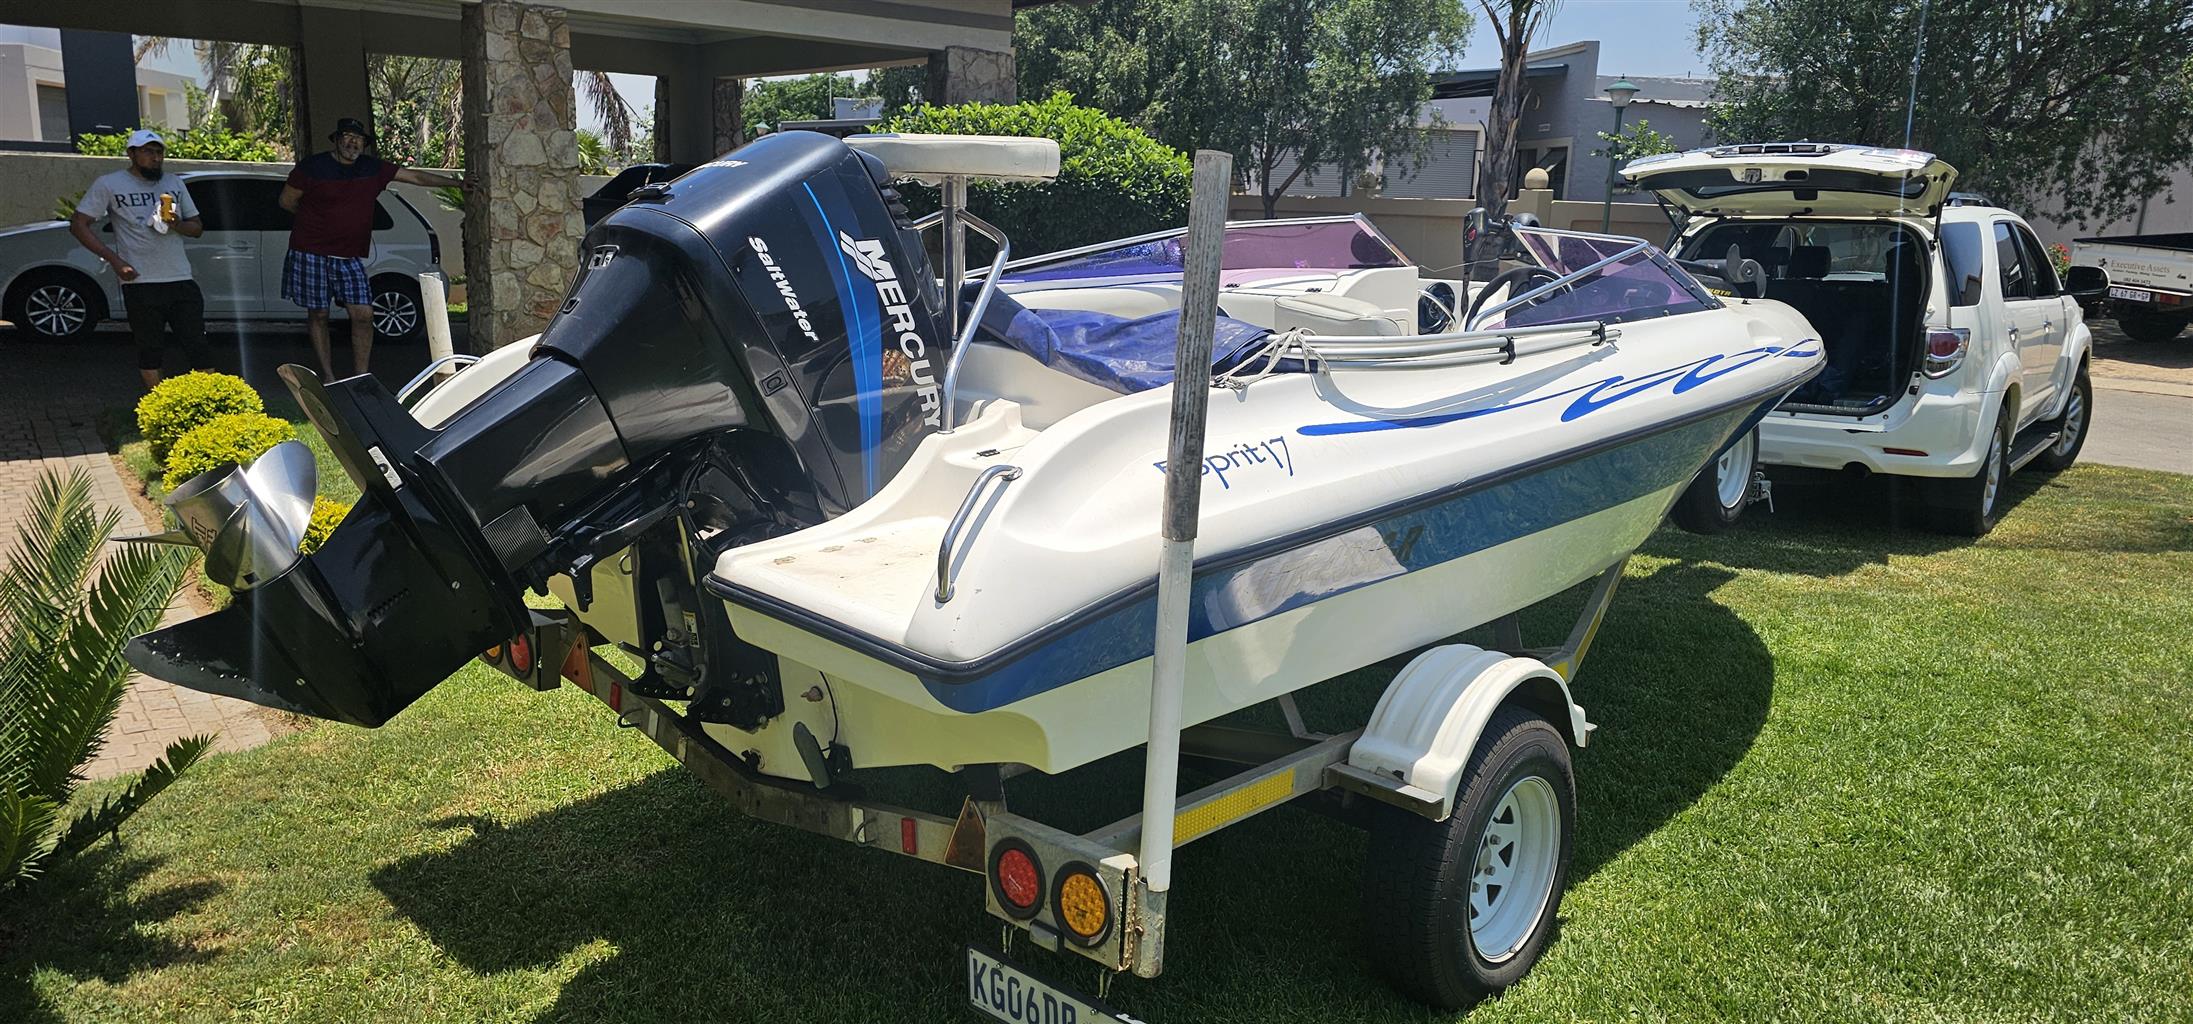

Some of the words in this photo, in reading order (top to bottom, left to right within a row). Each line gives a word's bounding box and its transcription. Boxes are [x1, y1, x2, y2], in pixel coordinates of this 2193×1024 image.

[114, 190, 181, 208] REPLY
[2111, 260, 2146, 271] Executive
[852, 238, 941, 427] MERCURY
